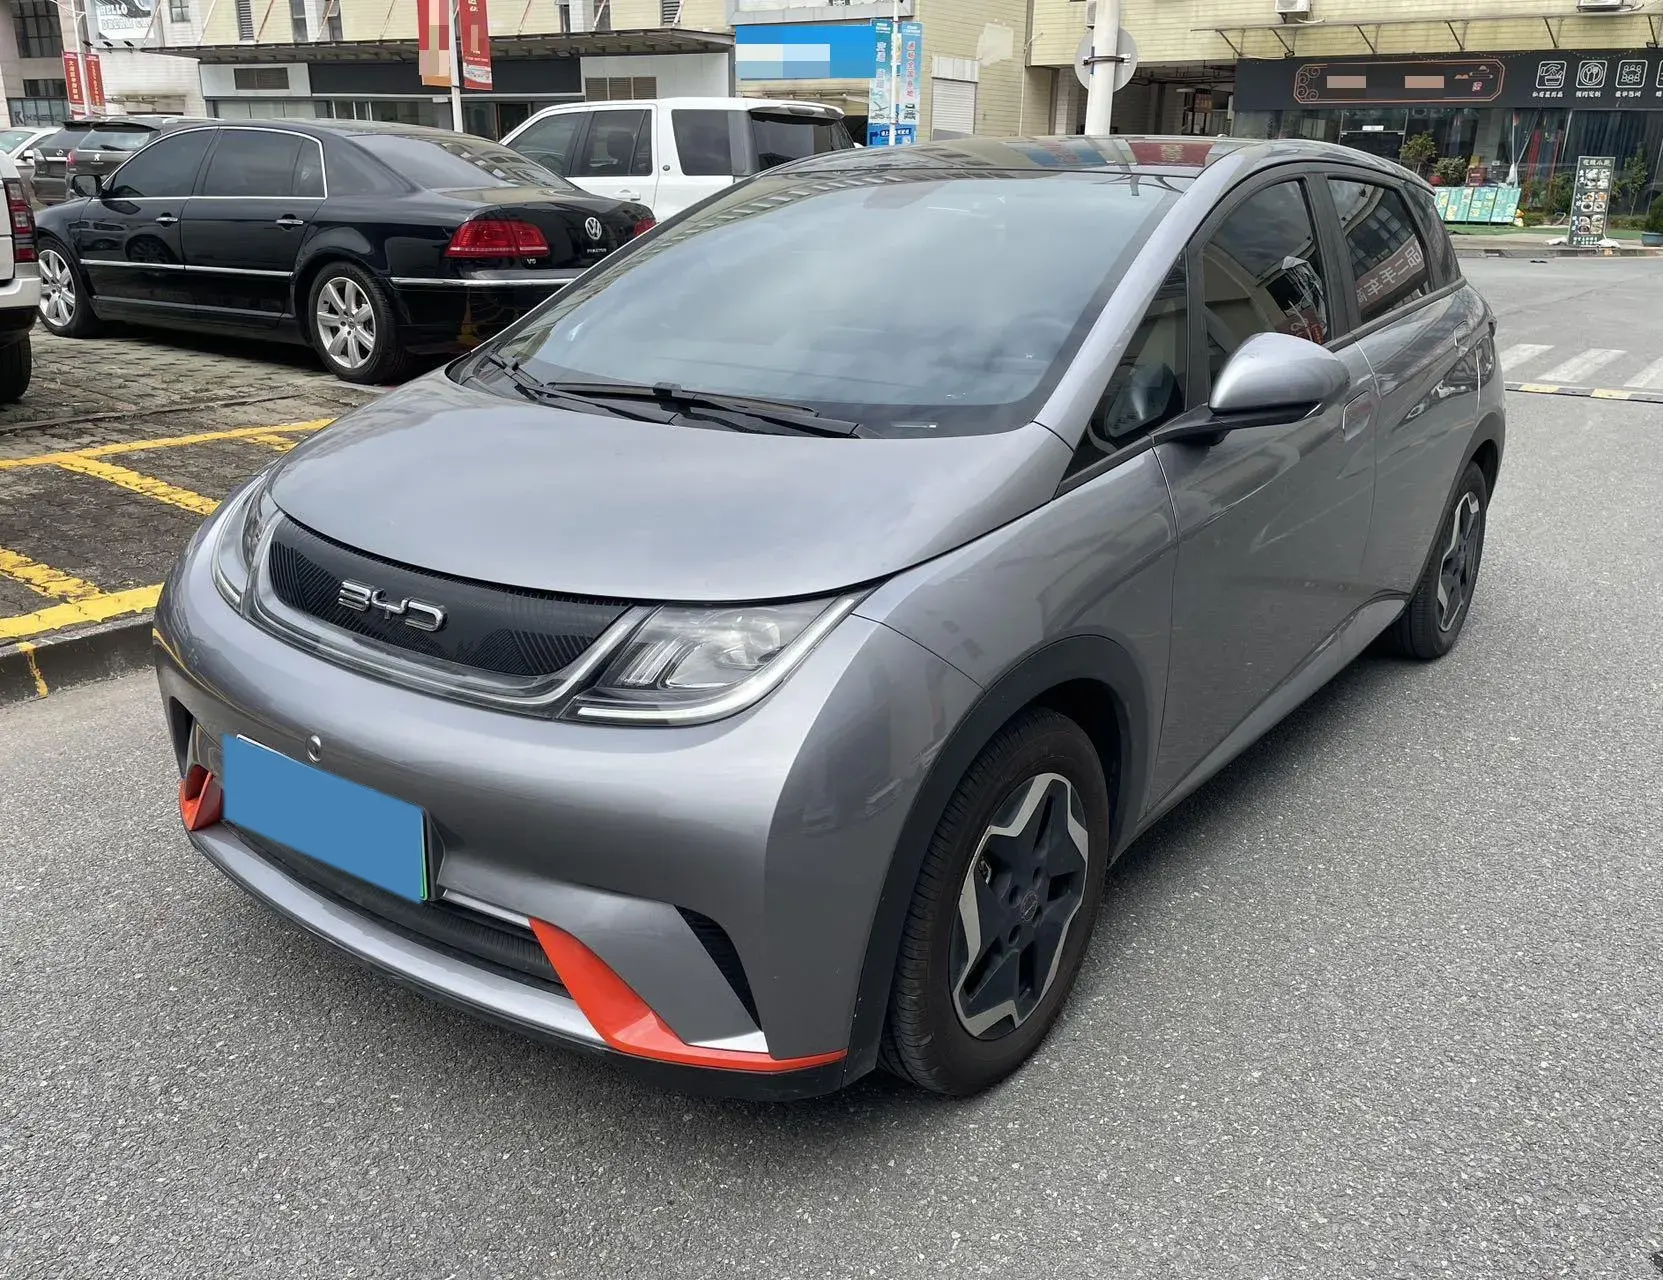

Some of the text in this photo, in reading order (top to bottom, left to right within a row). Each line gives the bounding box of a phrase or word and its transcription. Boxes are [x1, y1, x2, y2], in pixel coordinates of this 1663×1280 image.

[100, 4, 128, 15] HELLO
[102, 18, 133, 30] DREAM
[338, 580, 446, 632] BYD
